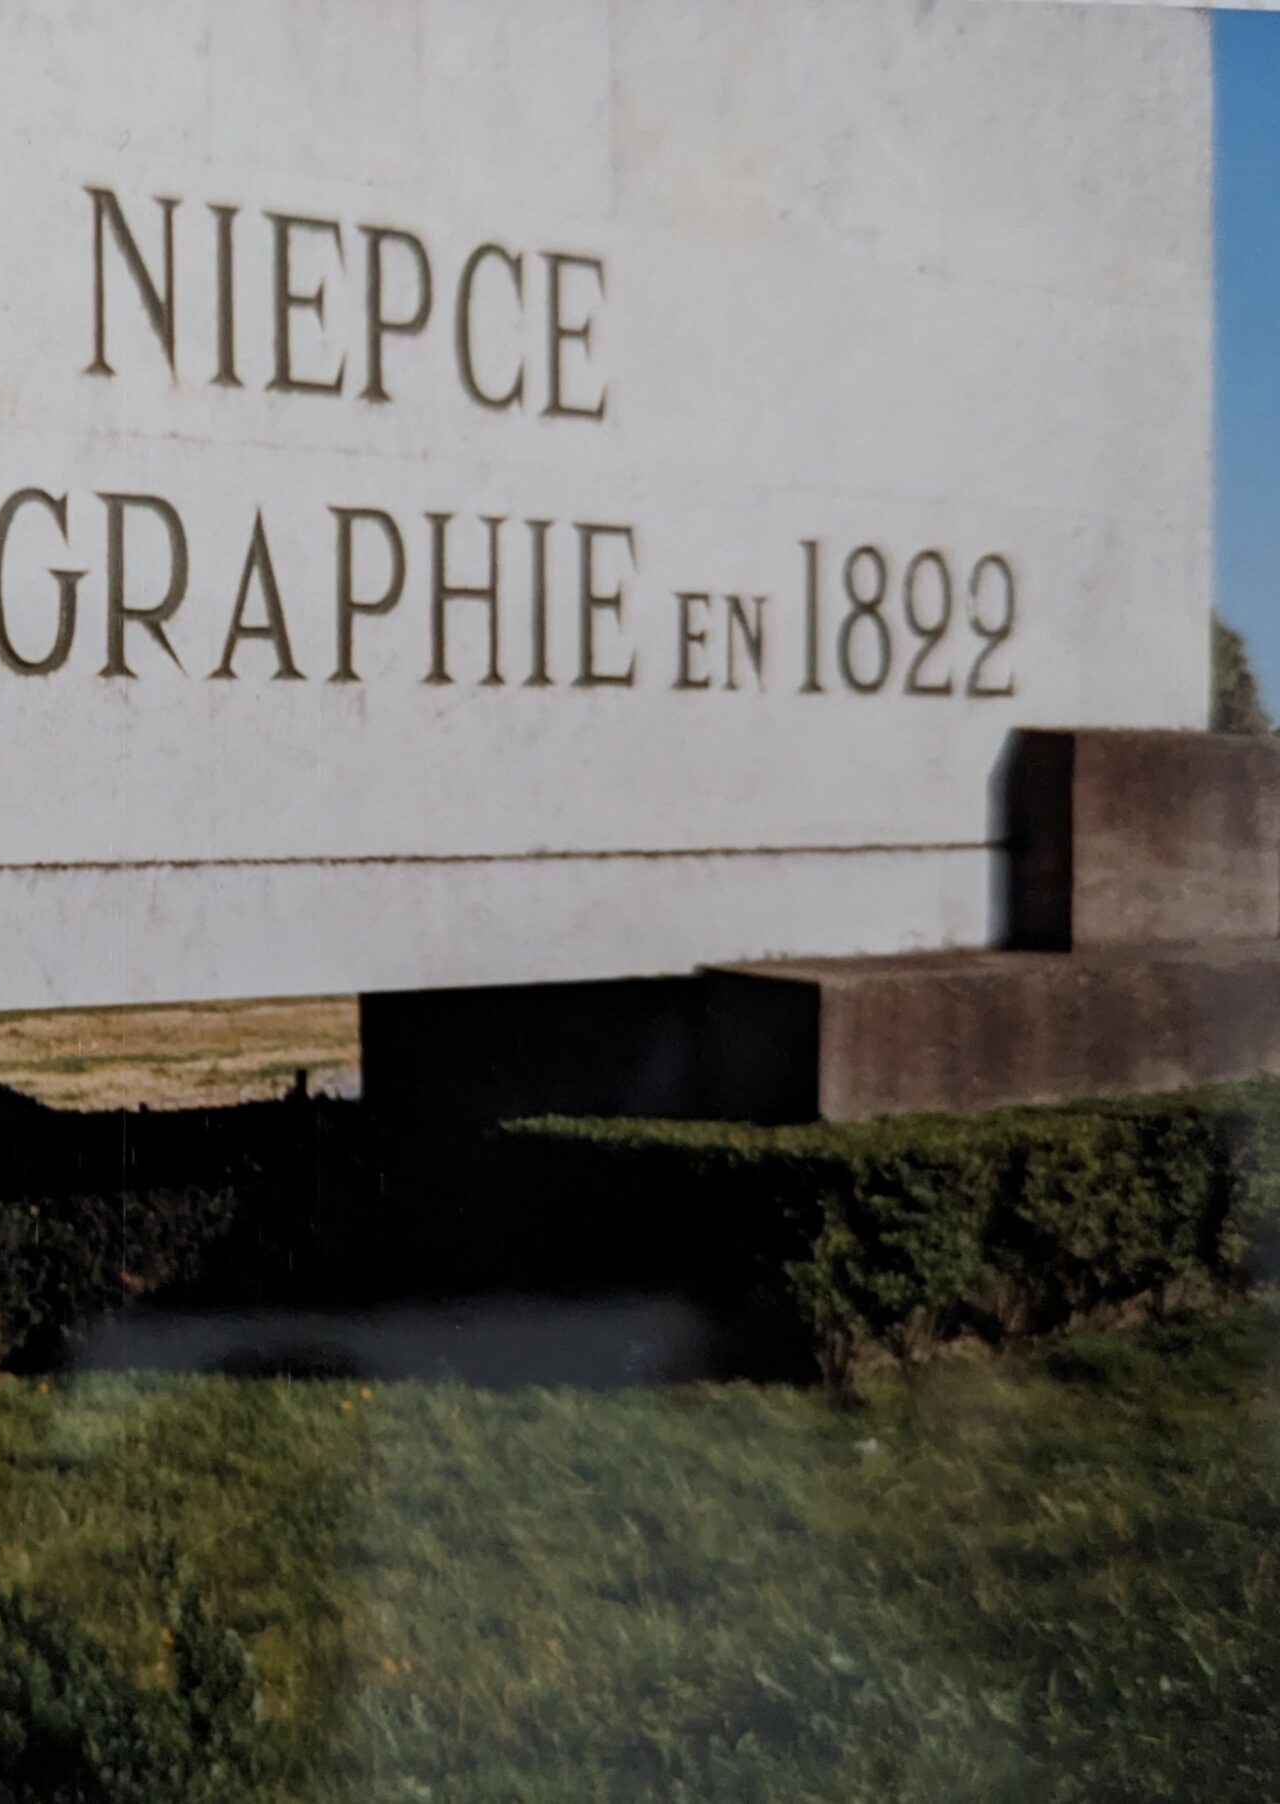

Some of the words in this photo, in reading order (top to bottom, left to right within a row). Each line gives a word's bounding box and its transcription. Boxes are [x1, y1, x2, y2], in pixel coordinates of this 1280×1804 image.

[81, 184, 609, 423] NIEPCE
[670, 590, 768, 693] EN
[797, 539, 1017, 698] 1822
